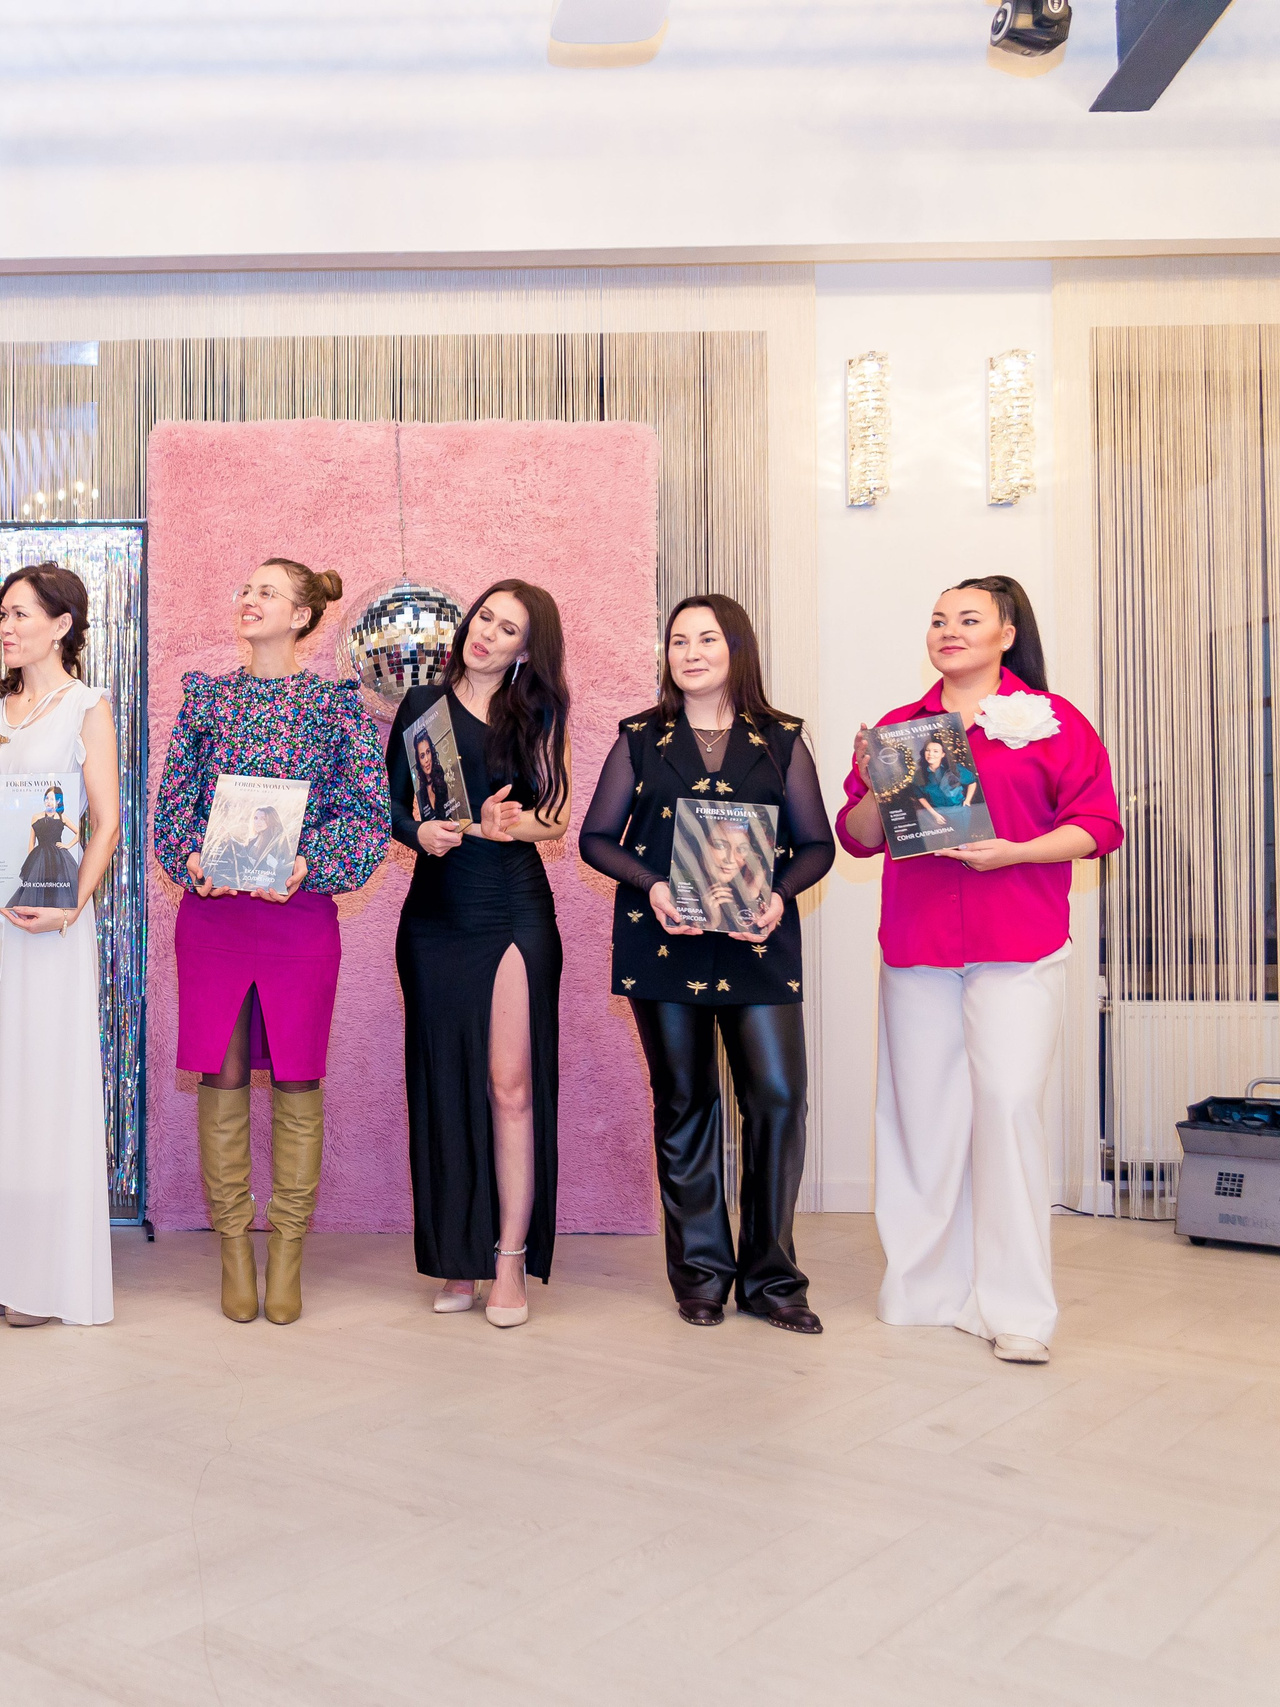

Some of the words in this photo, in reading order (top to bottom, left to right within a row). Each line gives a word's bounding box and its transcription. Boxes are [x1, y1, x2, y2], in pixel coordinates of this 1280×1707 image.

[880, 729, 911, 740] FORBES
[911, 722, 943, 733] WOMAN
[6, 780, 33, 788] FORBES
[33, 780, 62, 788] WOMAN
[234, 781, 261, 789] FORBES
[262, 783, 290, 791] WOMAN
[695, 807, 726, 816] FORBES
[726, 808, 758, 818] WOMAN
[897, 833, 915, 842] СОНЯ
